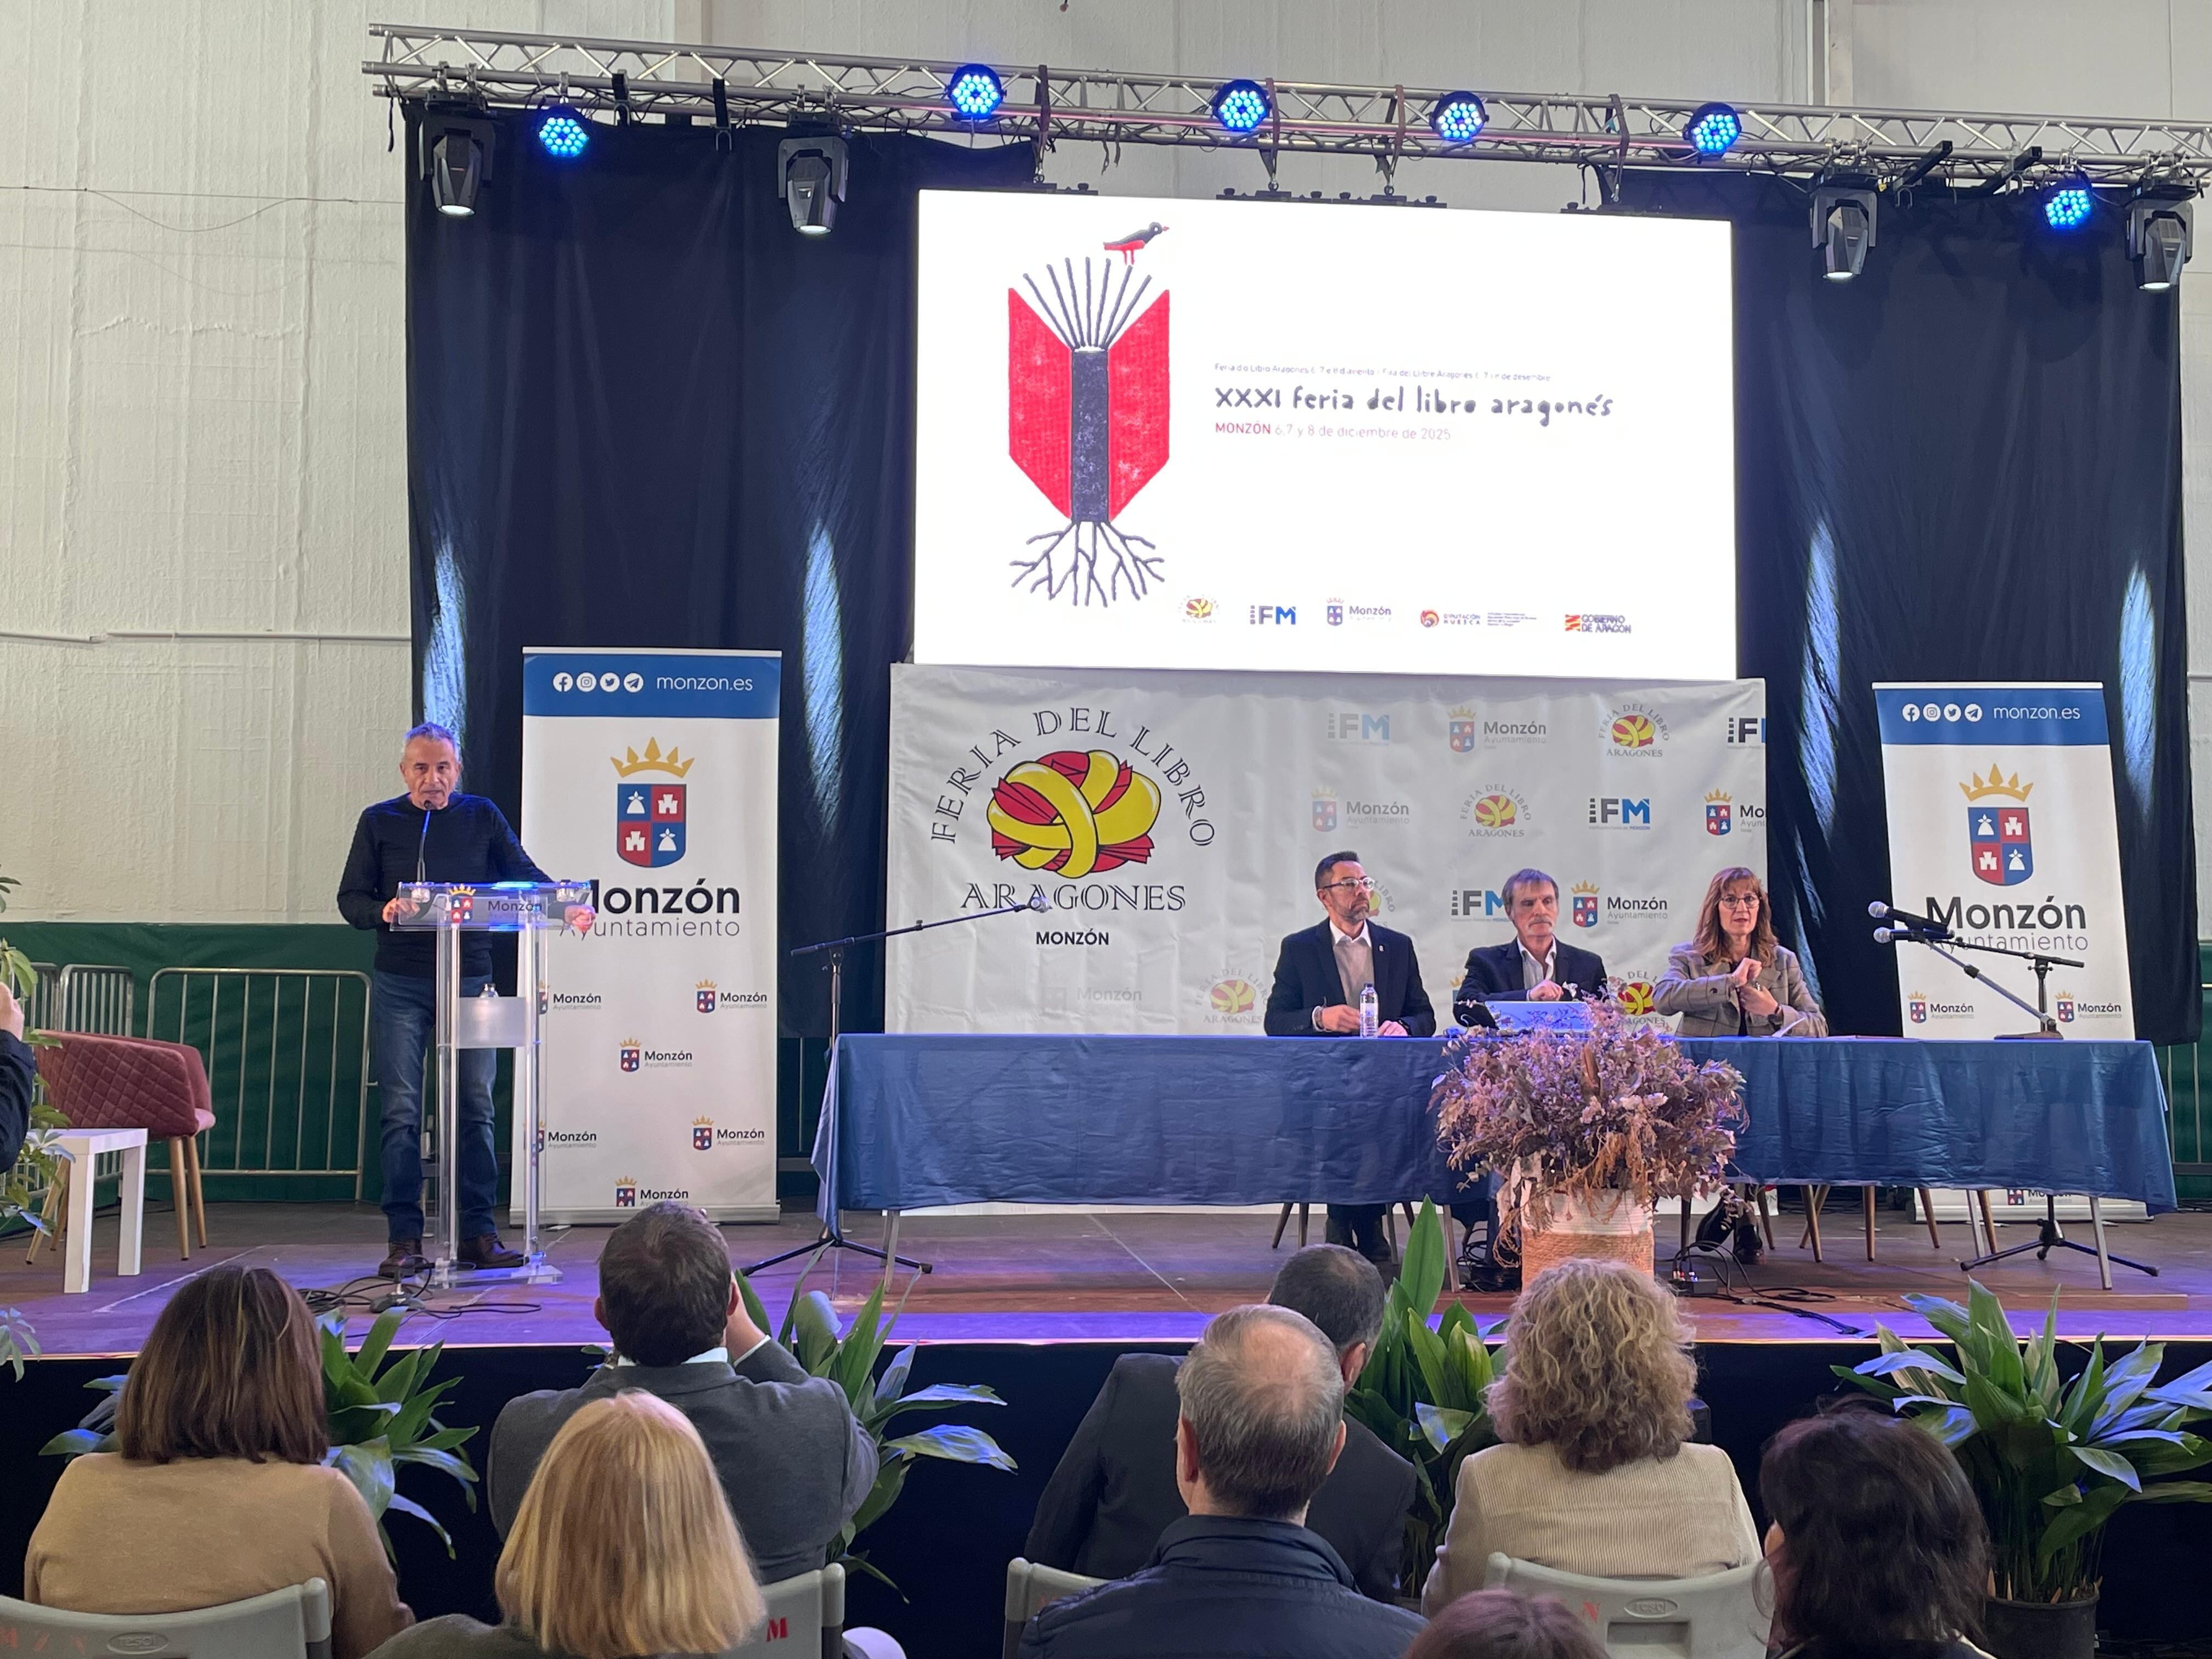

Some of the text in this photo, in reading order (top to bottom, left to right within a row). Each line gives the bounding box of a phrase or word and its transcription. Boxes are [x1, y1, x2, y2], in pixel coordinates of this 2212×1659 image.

[1215, 386, 1613, 427] XXXI feria del libro aragonés
[1297, 427, 1304, 438] y
[1308, 425, 1314, 437] 8
[1319, 426, 1333, 437] de
[1338, 427, 1398, 438] diciembre
[1402, 428, 1417, 439] de
[1422, 427, 1451, 440] 2025
[1349, 604, 1392, 615] Monzón
[1581, 624, 1593, 633] DE
[656, 677, 753, 691] monzon.es
[1993, 707, 2081, 720] monzon.es
[1483, 720, 1547, 735] Monzón
[1598, 703, 1669, 741] FERIA DEL LIBRO
[1483, 735, 1547, 744] Ayuntamiento
[1606, 749, 1663, 757] ARAGONES
[931, 707, 1215, 847] FERIA DEL LIBRO
[1460, 783, 1531, 820] FERIA DEL LIBRO
[1346, 801, 1409, 815] Monzón
[1346, 816, 1409, 825] Ayuntamiento
[1468, 829, 1525, 837] ARAGONES
[960, 883, 1186, 911] ARAGONES
[1607, 896, 1668, 910] Monzón
[1607, 911, 1668, 919] Ayuntamiento
[1926, 895, 2086, 929] Monzón
[1036, 928, 1109, 945] MONZÓN
[1627, 970, 1649, 979] DEL
[554, 993, 601, 1003] Monzón
[720, 992, 767, 1002] Monzón
[1077, 986, 1142, 1001] Monzón
[1931, 1003, 1973, 1013] Monzón
[2078, 1003, 2121, 1012] Monzón
[1203, 1015, 1262, 1024] ARAGONES
[645, 1050, 692, 1060] Monzón
[549, 1131, 596, 1142] Monzón
[717, 1128, 764, 1139] Monzón
[641, 1188, 689, 1199] Monzón
[766, 1617, 788, 1641] M
